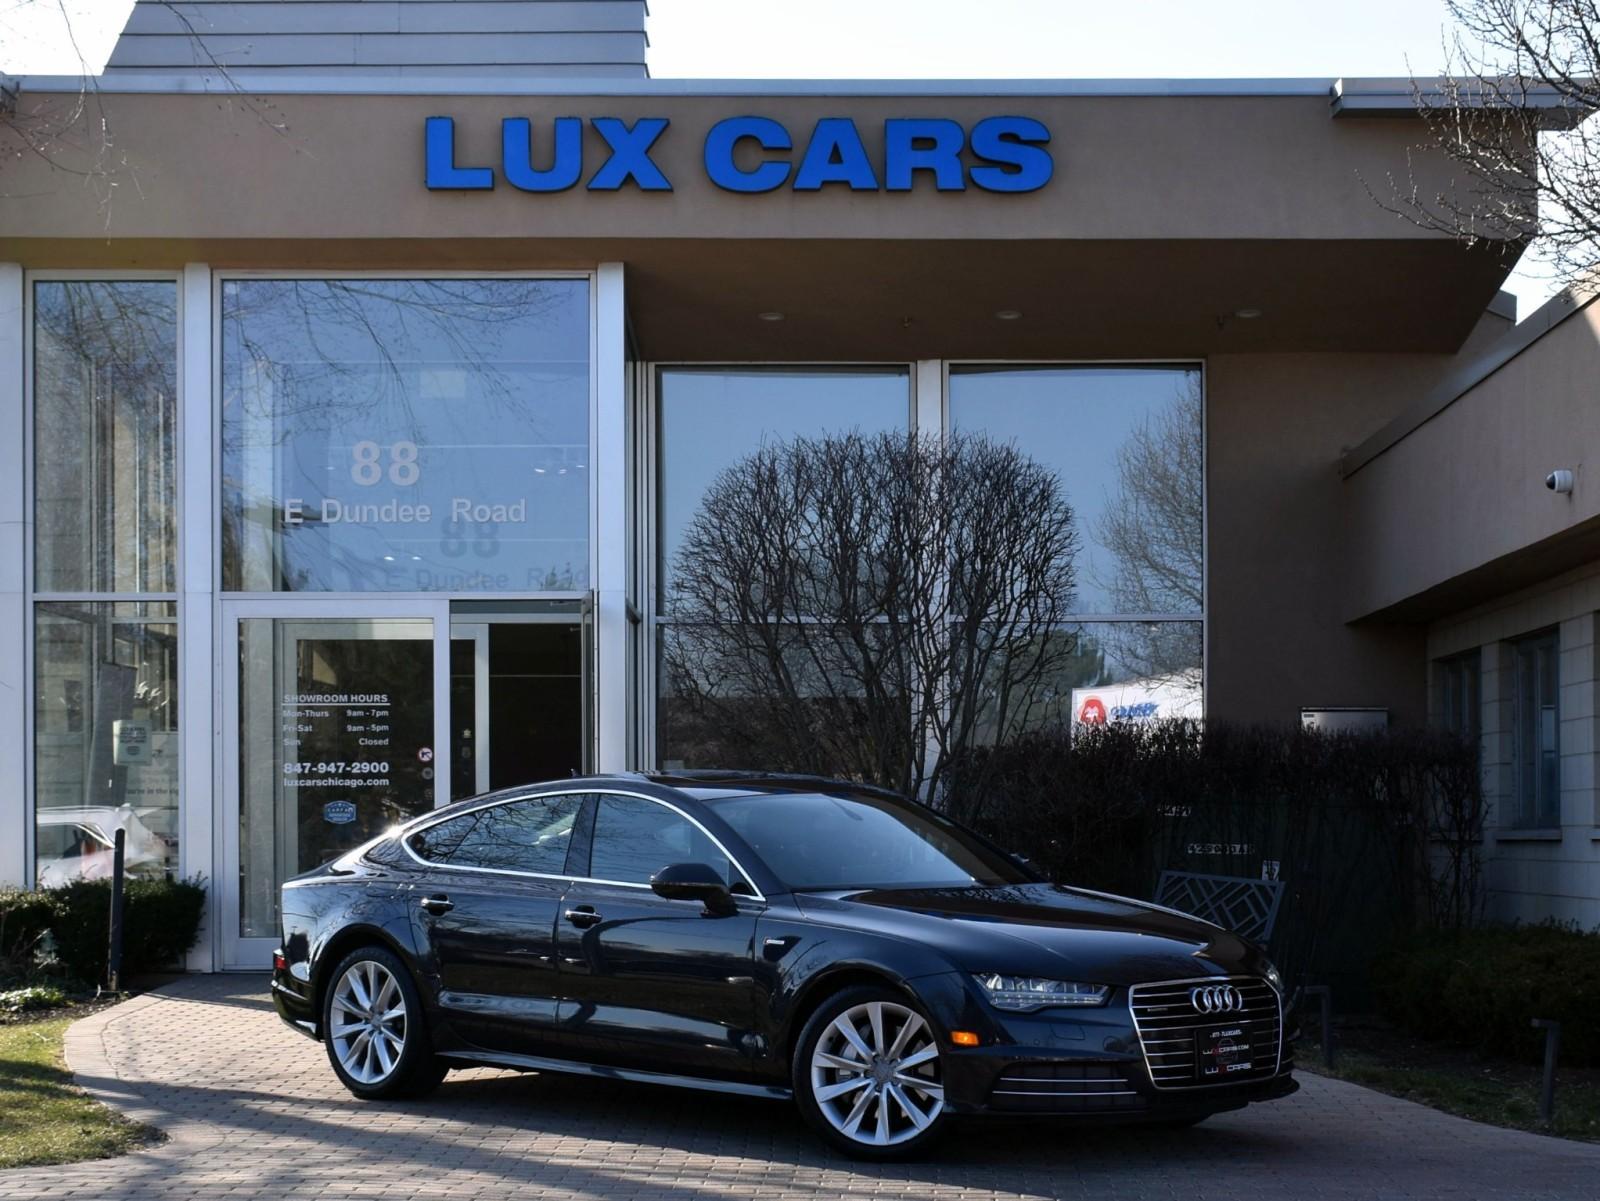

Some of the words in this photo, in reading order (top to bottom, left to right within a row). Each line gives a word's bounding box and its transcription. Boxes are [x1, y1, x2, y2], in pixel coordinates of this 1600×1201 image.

[425, 116, 673, 192] LUX
[703, 115, 1054, 193] CARS
[351, 441, 420, 486] 88
[284, 499, 304, 524] E
[321, 498, 432, 524] Dundee
[452, 498, 527, 523] Road
[284, 694, 348, 703] SHOWROOM
[350, 694, 388, 703] HOURS
[283, 709, 329, 717] Mon-Thurs
[347, 709, 364, 717] 9am
[371, 709, 389, 718] 7pm
[283, 724, 312, 732] Fri-Sat
[371, 724, 389, 732] 5pm
[359, 738, 389, 746] Closed
[284, 762, 389, 774] 847-947-2900
[284, 777, 389, 788] luxcarschicago.com
